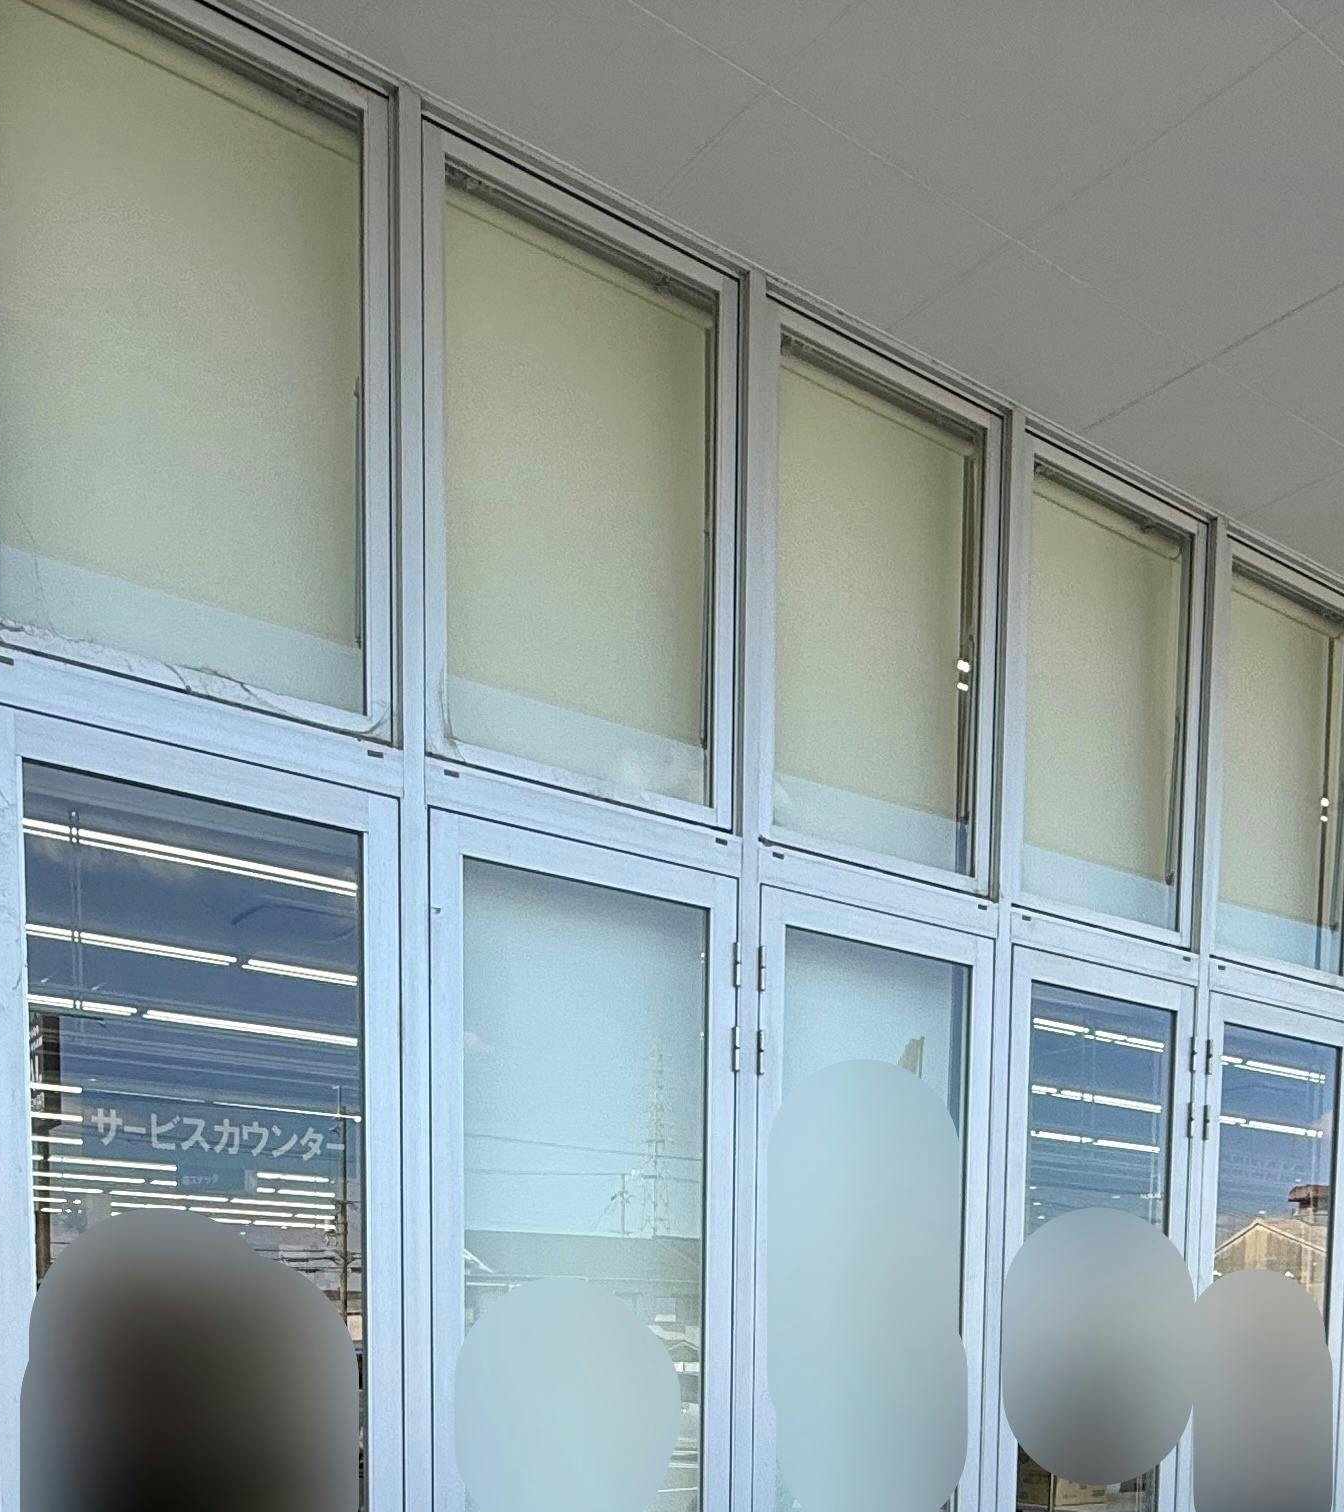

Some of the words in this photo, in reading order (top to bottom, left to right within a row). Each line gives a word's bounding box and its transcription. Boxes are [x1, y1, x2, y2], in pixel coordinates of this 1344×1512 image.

[90, 1106, 346, 1161] サービスカウンター
